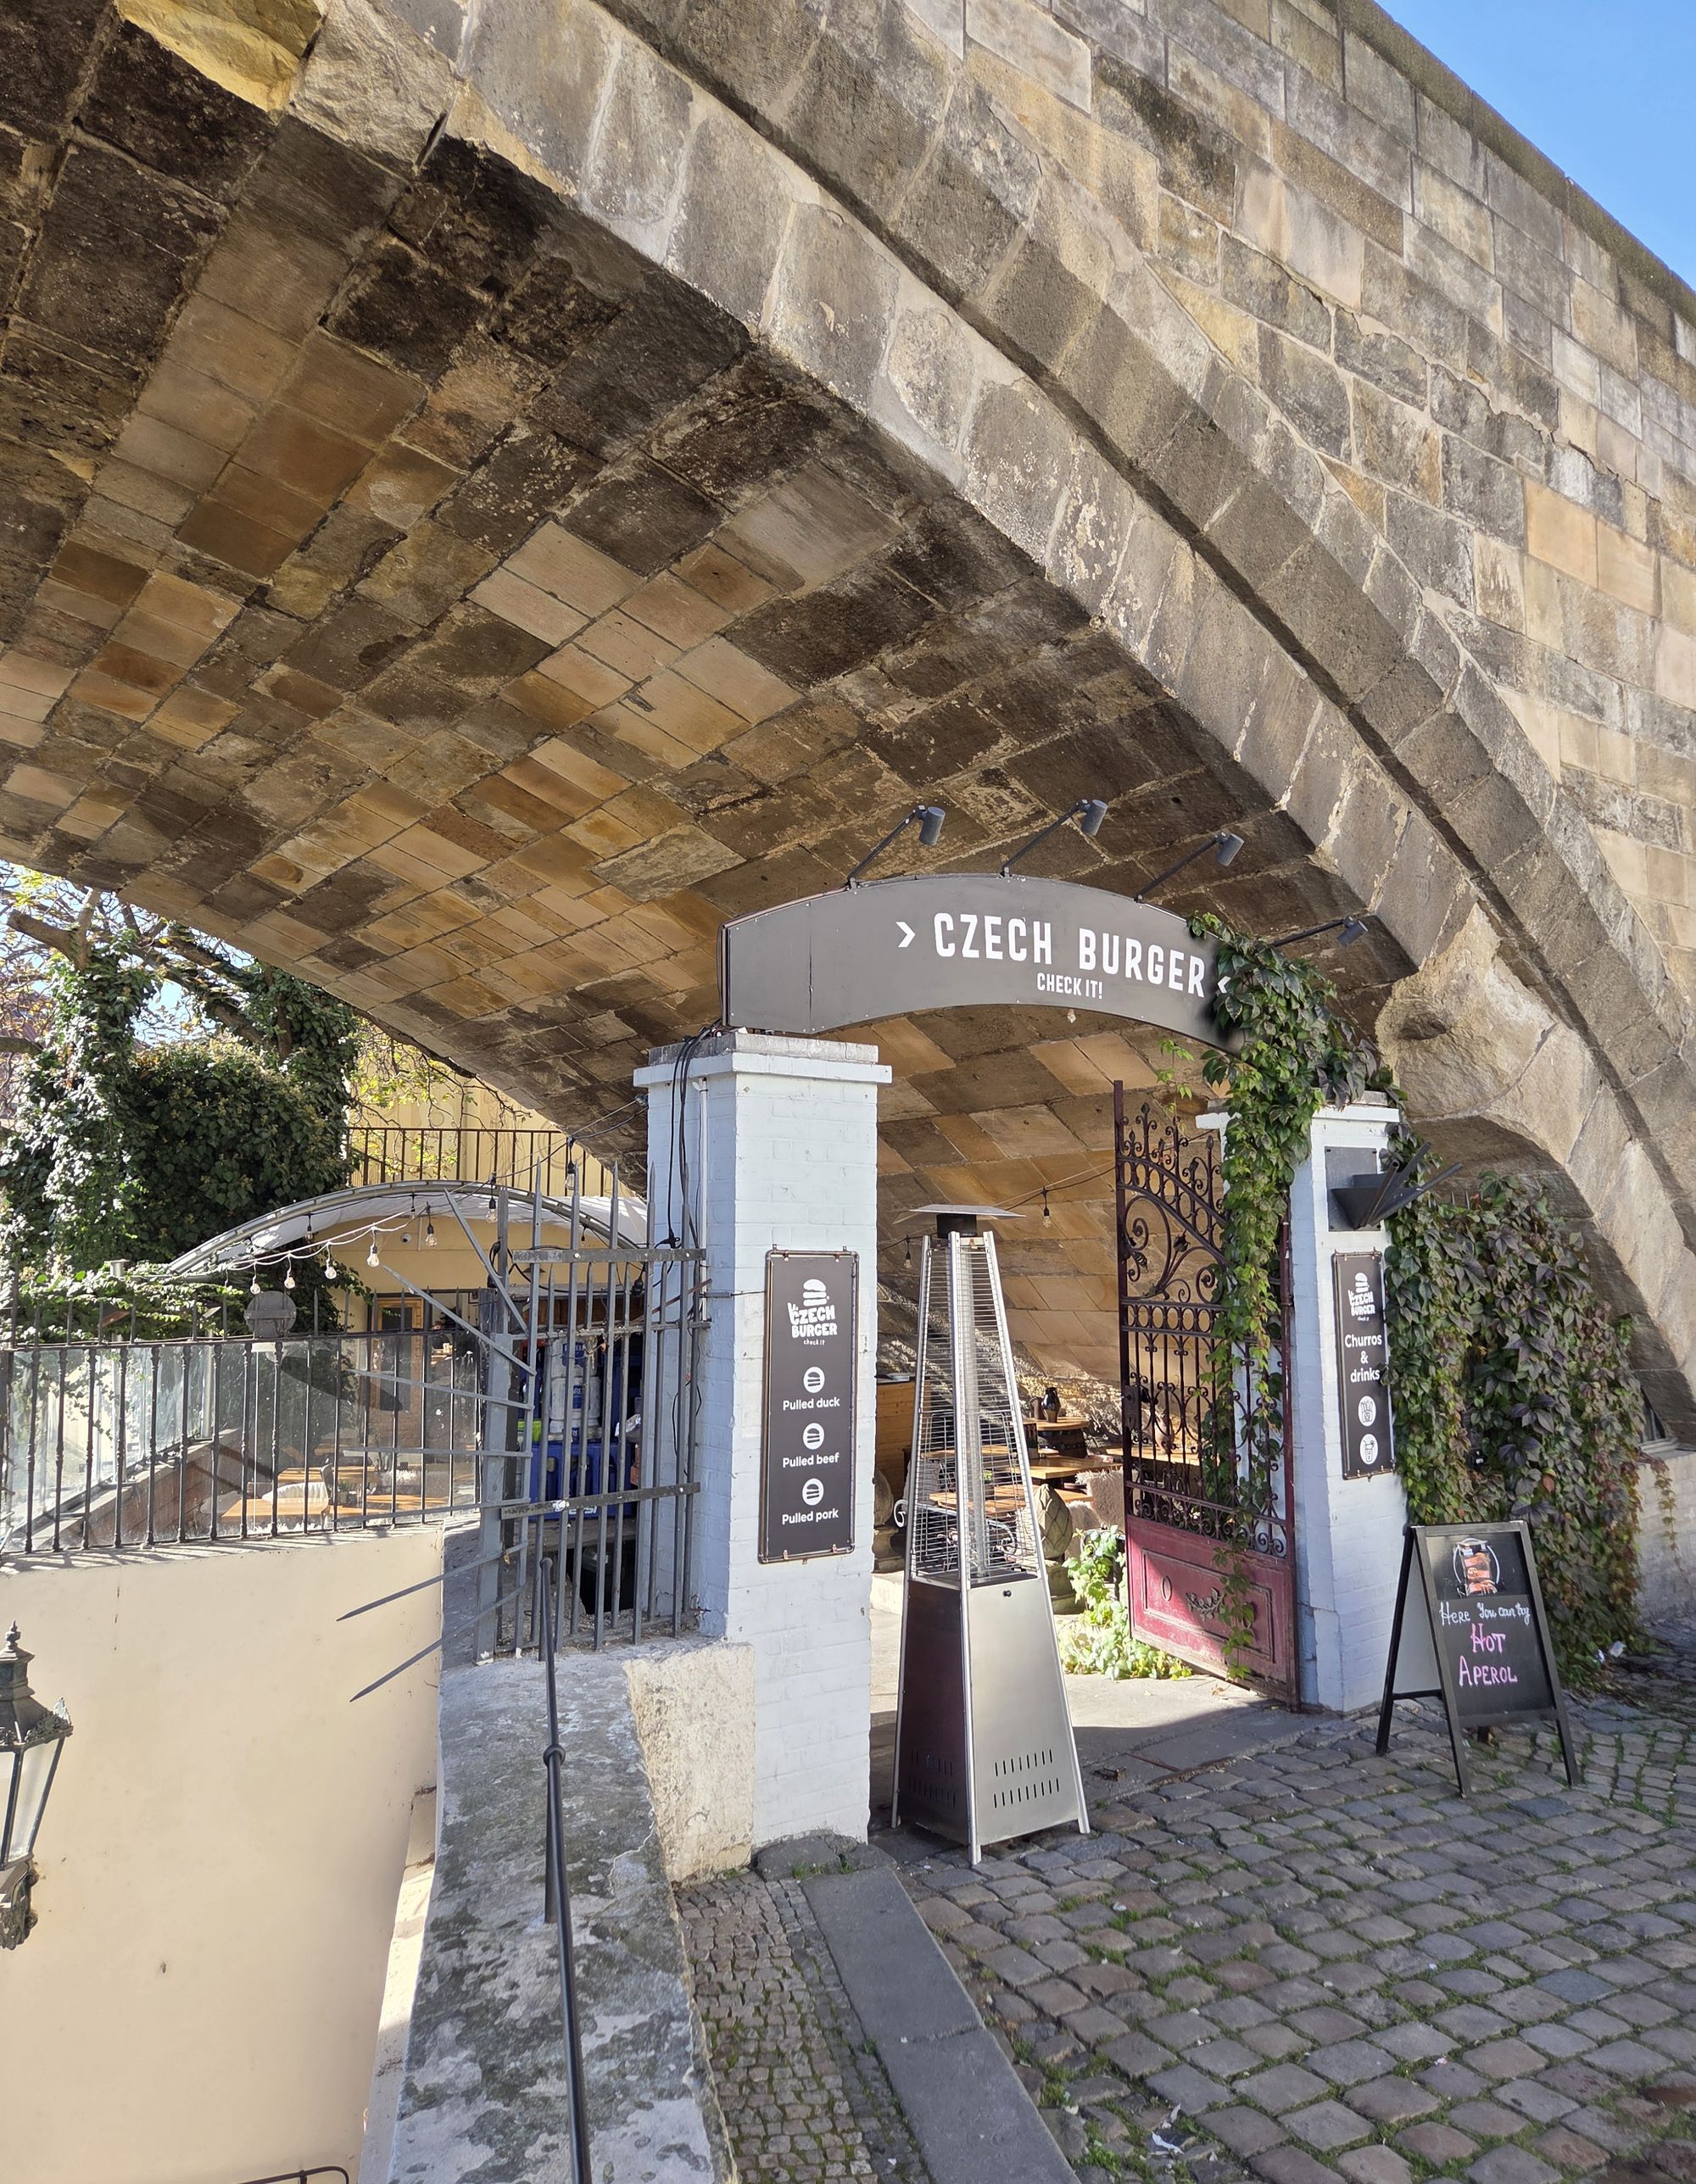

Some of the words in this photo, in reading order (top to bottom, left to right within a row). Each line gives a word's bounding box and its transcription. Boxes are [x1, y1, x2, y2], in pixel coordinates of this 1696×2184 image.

[934, 912, 1052, 965] CZECH
[1079, 928, 1206, 998] BURGER
[1036, 972, 1082, 997] CHECK
[1085, 978, 1103, 1000] IT!
[1348, 1290, 1374, 1306] CZECH
[788, 1303, 835, 1325] CZECH
[1351, 1304, 1375, 1316] BURGER
[791, 1323, 838, 1338] BURGER
[1344, 1334, 1382, 1348] Churros
[1360, 1350, 1369, 1364] &
[1350, 1367, 1381, 1383] drinks
[783, 1398, 814, 1411] Pulled
[816, 1396, 840, 1408] duck
[783, 1455, 814, 1468] Pulled
[816, 1452, 840, 1465] beef
[782, 1511, 814, 1525] Pulled
[816, 1508, 839, 1523] pork
[1498, 1606, 1516, 1618] can
[1515, 1602, 1531, 1626] try
[1470, 1623, 1506, 1654] HOT
[1459, 1655, 1518, 1686] APEROL
